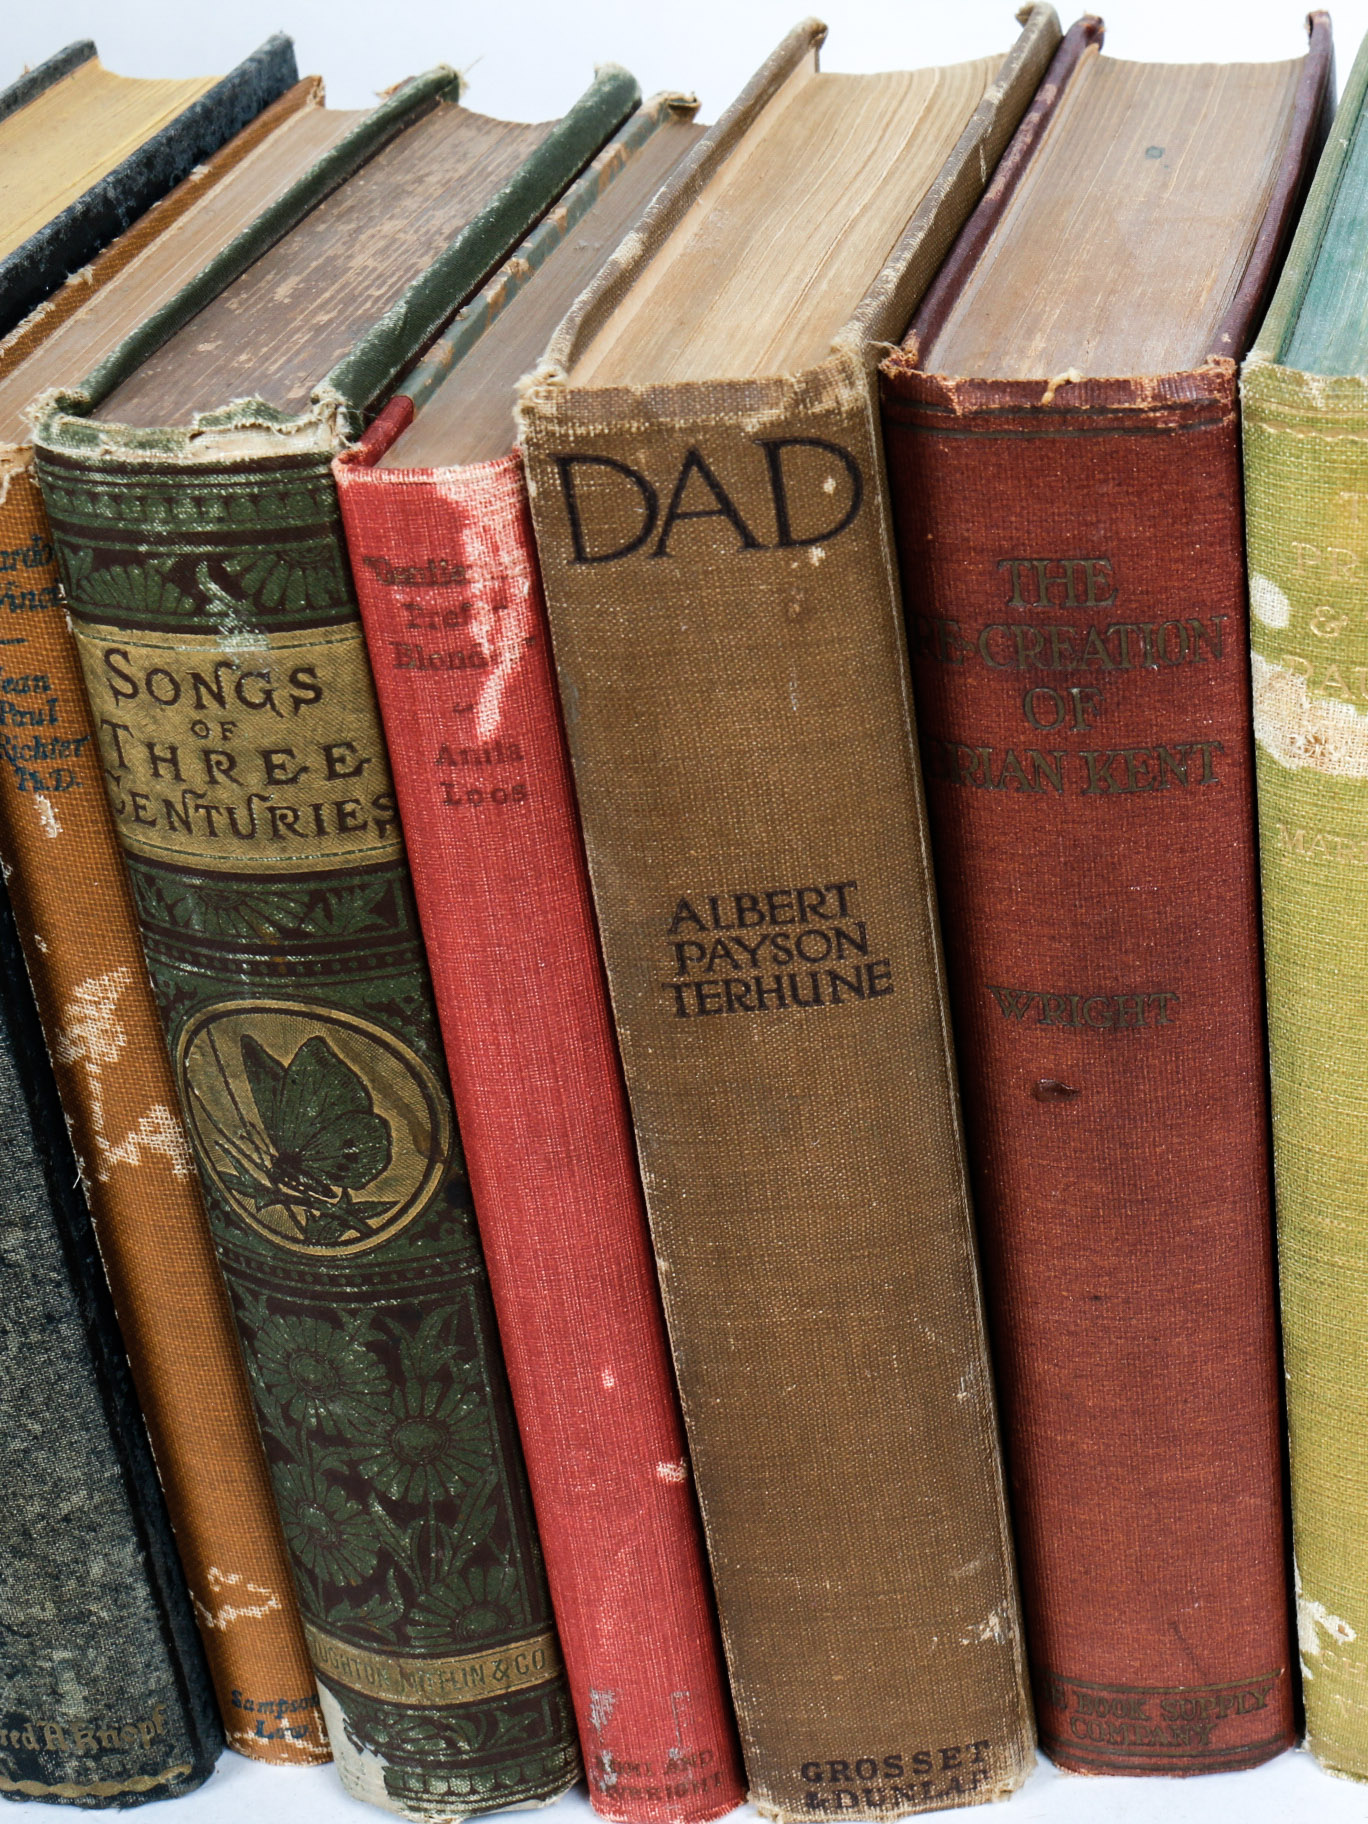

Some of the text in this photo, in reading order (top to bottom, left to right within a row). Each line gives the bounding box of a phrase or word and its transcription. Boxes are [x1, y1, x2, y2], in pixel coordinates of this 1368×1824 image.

[546, 435, 865, 567] DAD
[996, 557, 1119, 608] THE
[1309, 605, 1349, 638] &
[0, 668, 51, 694] ean
[103, 648, 324, 719] SONGS
[190, 718, 239, 742] OF
[1021, 686, 1105, 732] OF
[100, 718, 373, 787] THREE
[1078, 740, 1226, 795] KENT
[439, 781, 528, 808] Loos
[666, 879, 858, 936] ALBERT
[673, 920, 869, 978] PAYSON
[661, 957, 895, 1020] TERHUNE
[985, 983, 1181, 1029] WRIGHT
[491, 1659, 512, 1683] &
[1073, 1689, 1152, 1722] BOOK
[1160, 1684, 1275, 1722] SUPPLY
[253, 1719, 312, 1740] Low
[1069, 1716, 1219, 1748] COMPANY
[800, 1738, 991, 1784] GROSSET
[832, 1768, 991, 1812] DUNLAP
